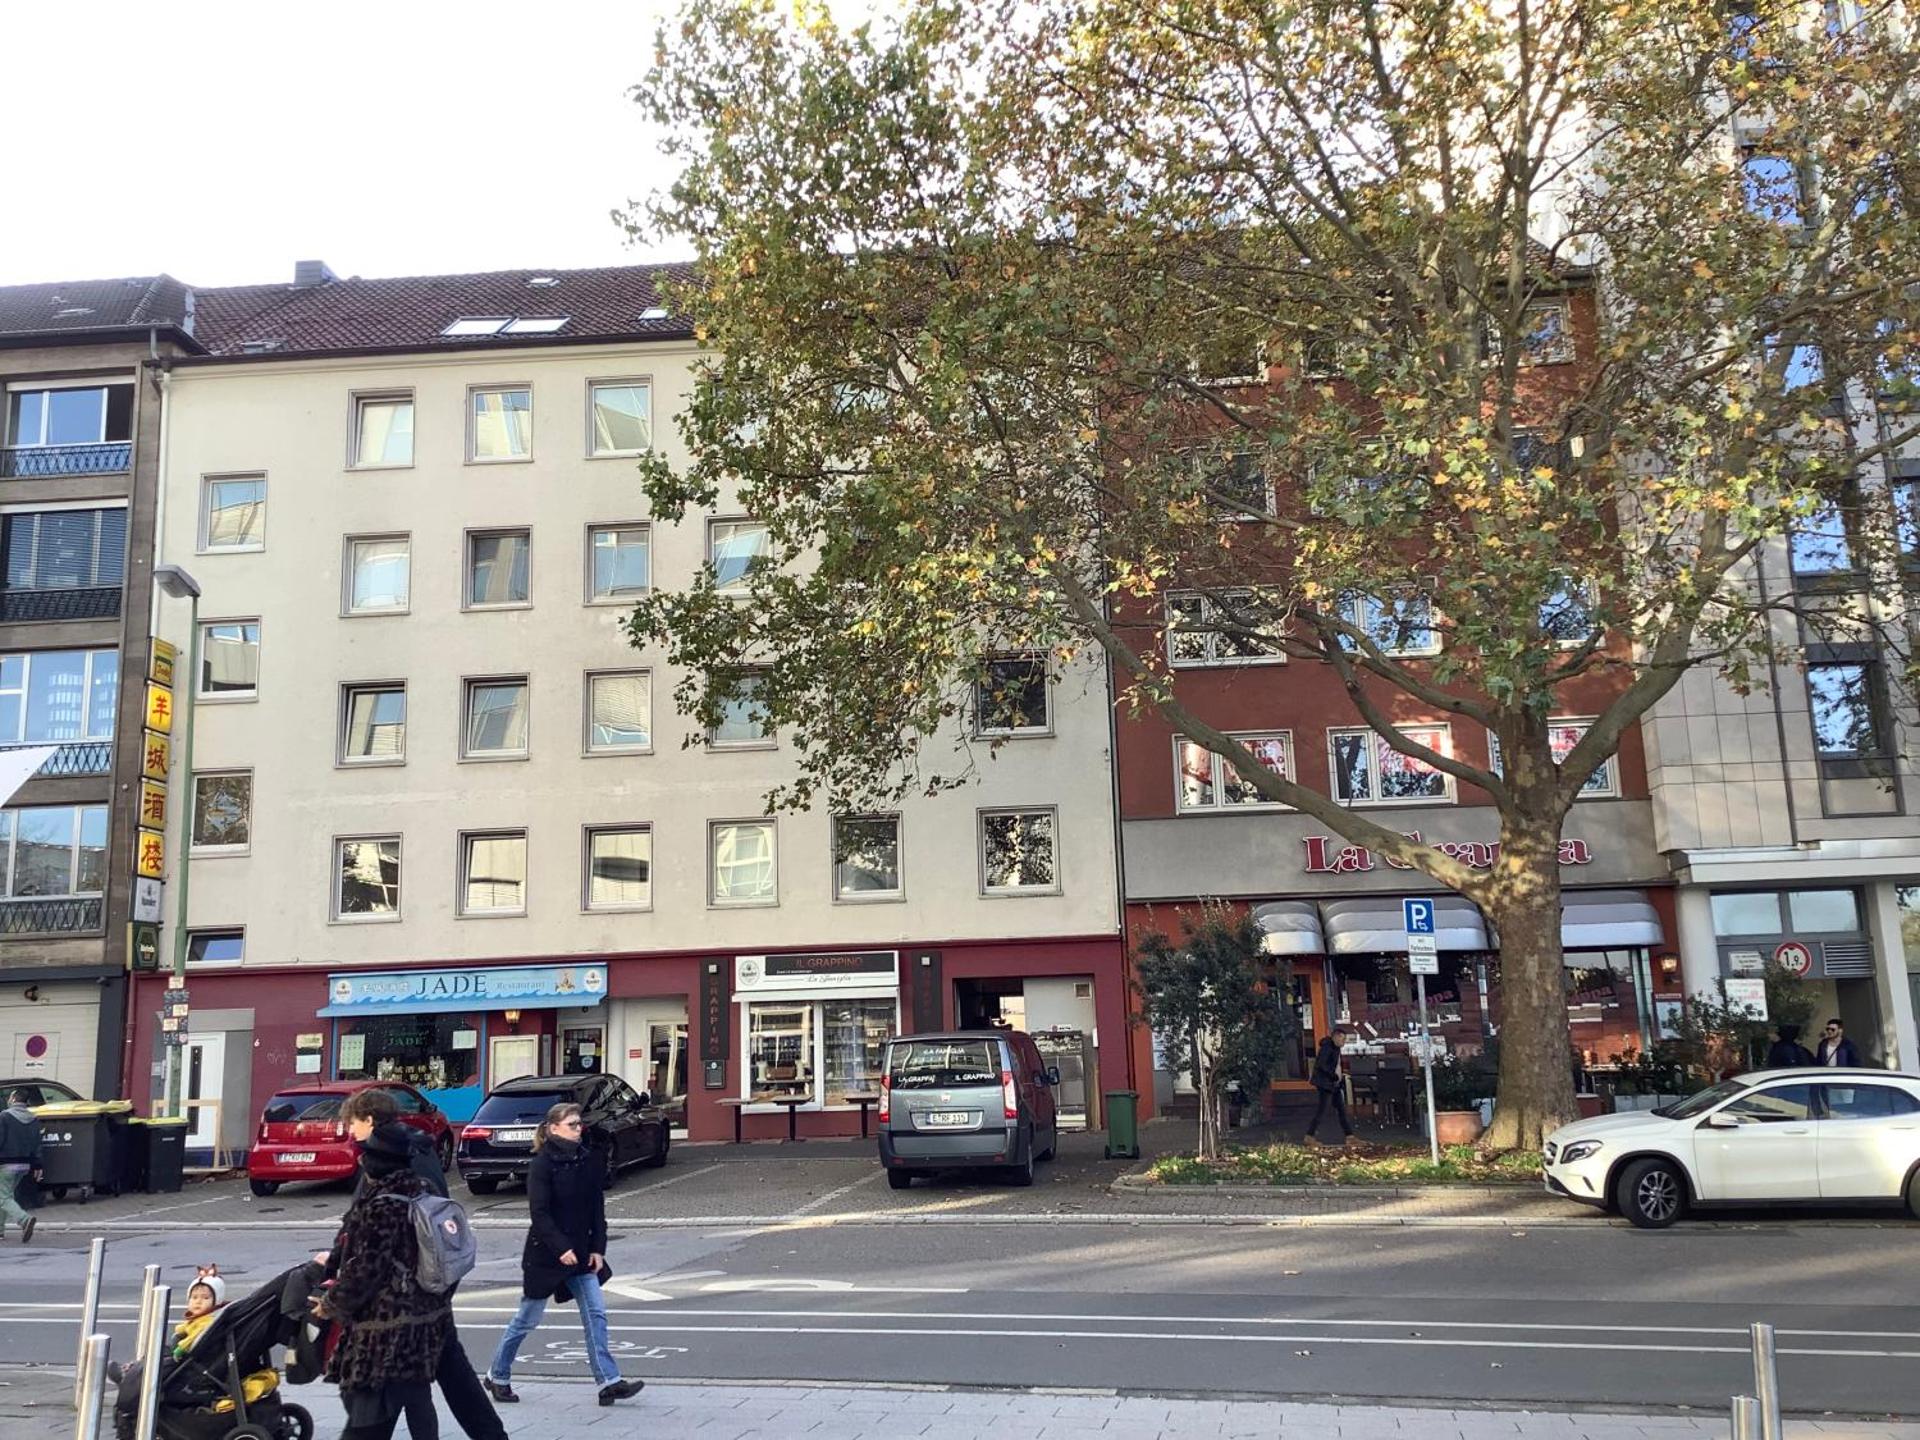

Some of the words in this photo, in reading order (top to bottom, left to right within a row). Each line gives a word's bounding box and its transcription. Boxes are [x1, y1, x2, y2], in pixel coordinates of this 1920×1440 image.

[1303, 835, 1375, 874] La
[1411, 904, 1428, 930] P
[807, 957, 863, 968] GRAPPINO
[416, 975, 487, 995] JADE
[254, 1038, 260, 1047] 6
[388, 1036, 424, 1046] JADE
